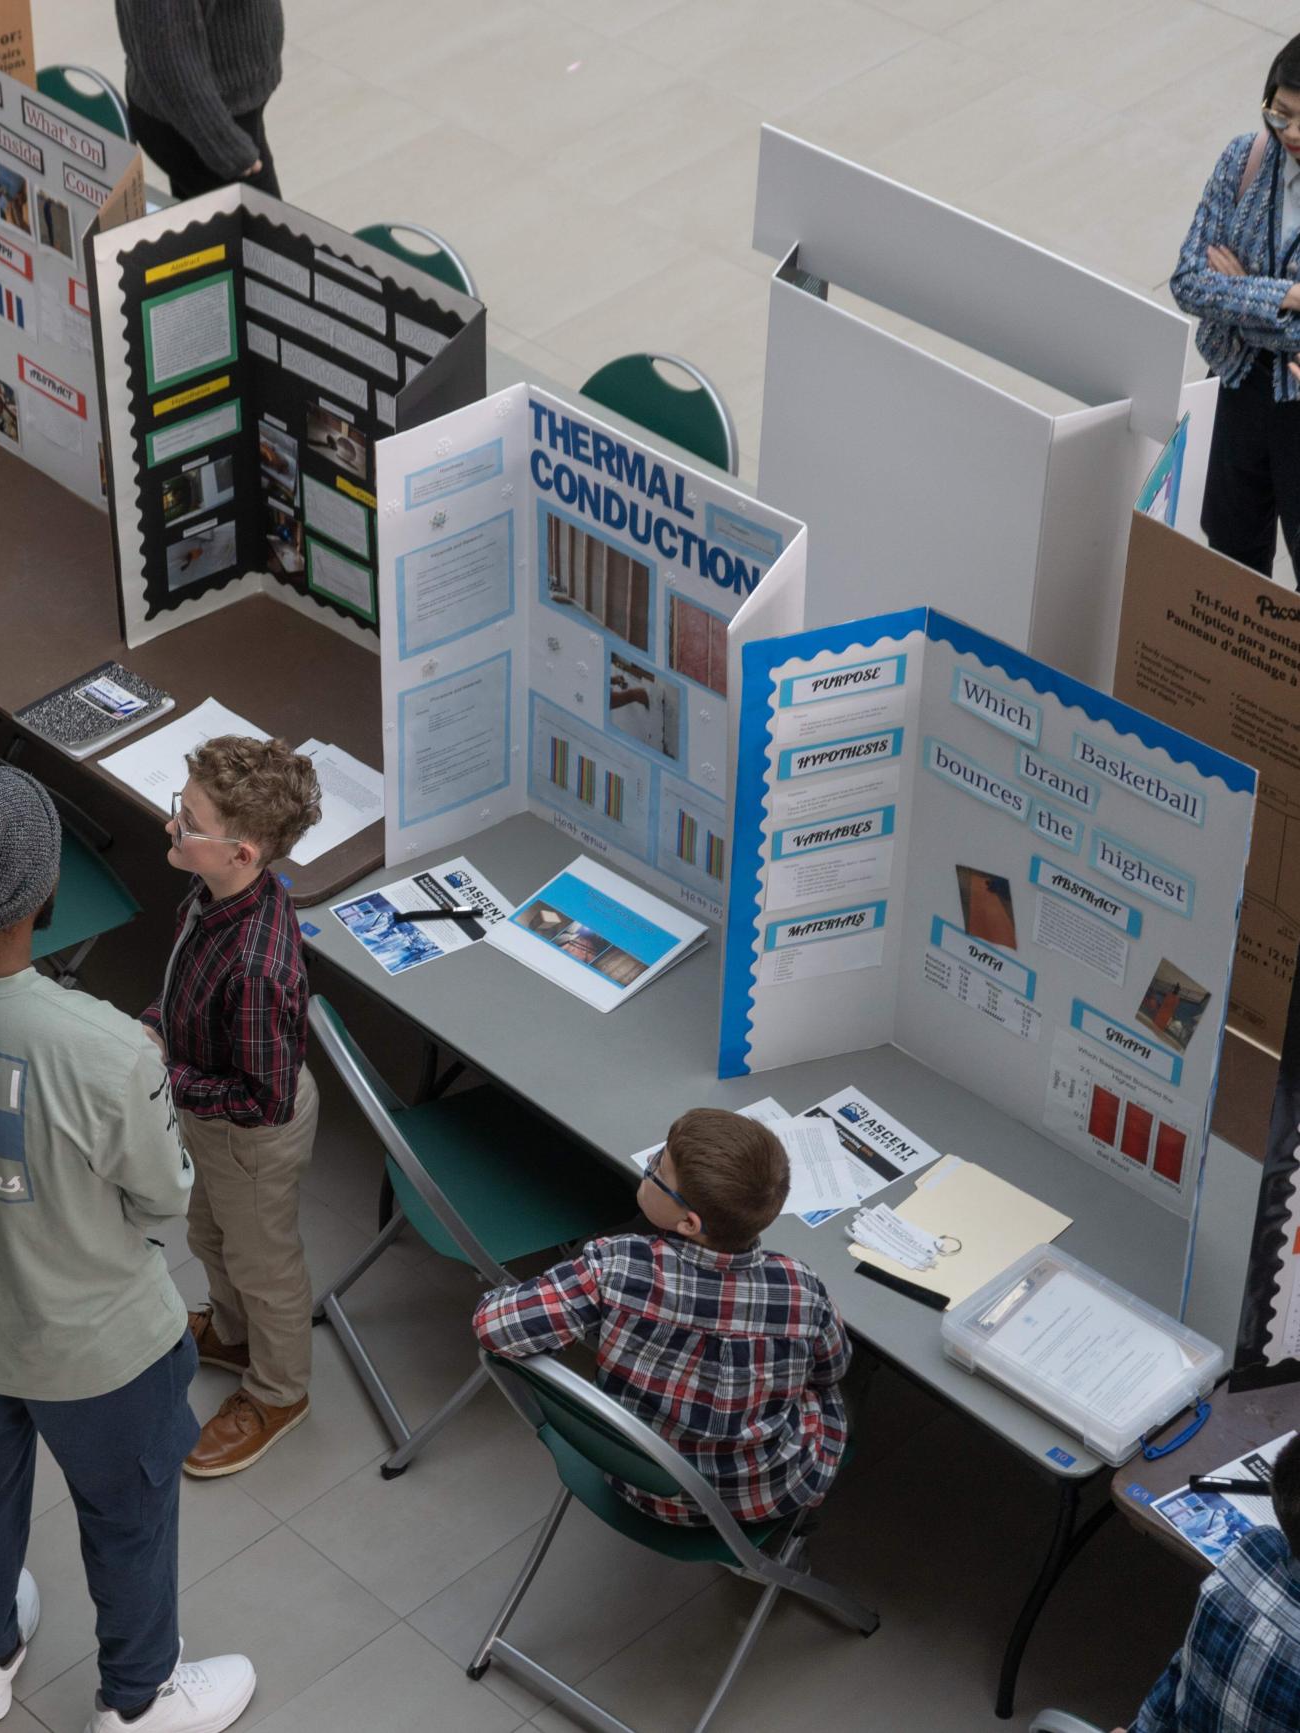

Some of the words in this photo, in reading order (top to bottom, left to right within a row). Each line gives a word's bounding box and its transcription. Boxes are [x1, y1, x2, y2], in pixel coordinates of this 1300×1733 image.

[26, 104, 77, 149] What's
[81, 140, 101, 164] On
[30, 369, 74, 401] ABSTRACT
[529, 398, 695, 520] THERMAL
[530, 449, 760, 596] CONDUCTION
[1195, 589, 1240, 622] Tri-Fold
[1166, 609, 1217, 645] Panneau
[1220, 639, 1286, 682] d'affichage
[1190, 603, 1234, 637] Triptico
[1238, 631, 1266, 654] para
[812, 667, 881, 692] PURPOSE
[963, 679, 1032, 731] Which
[797, 739, 888, 769] HYPOTHESIS
[1024, 754, 1089, 805] brand
[1079, 741, 1198, 818] Basketball
[793, 820, 873, 847] VARIABLES
[935, 746, 1023, 812] bounces
[1037, 809, 1073, 841] the
[1101, 841, 1185, 903] highest
[465, 885, 507, 923] ASCENT
[1052, 874, 1122, 916] ABSTRACT
[788, 912, 866, 938] MATERIALS
[969, 944, 1004, 972] DATA
[1105, 1026, 1152, 1060] GRAPH
[857, 1122, 909, 1163] ECOSYSTEM
[863, 1118, 919, 1158] ASCENT
